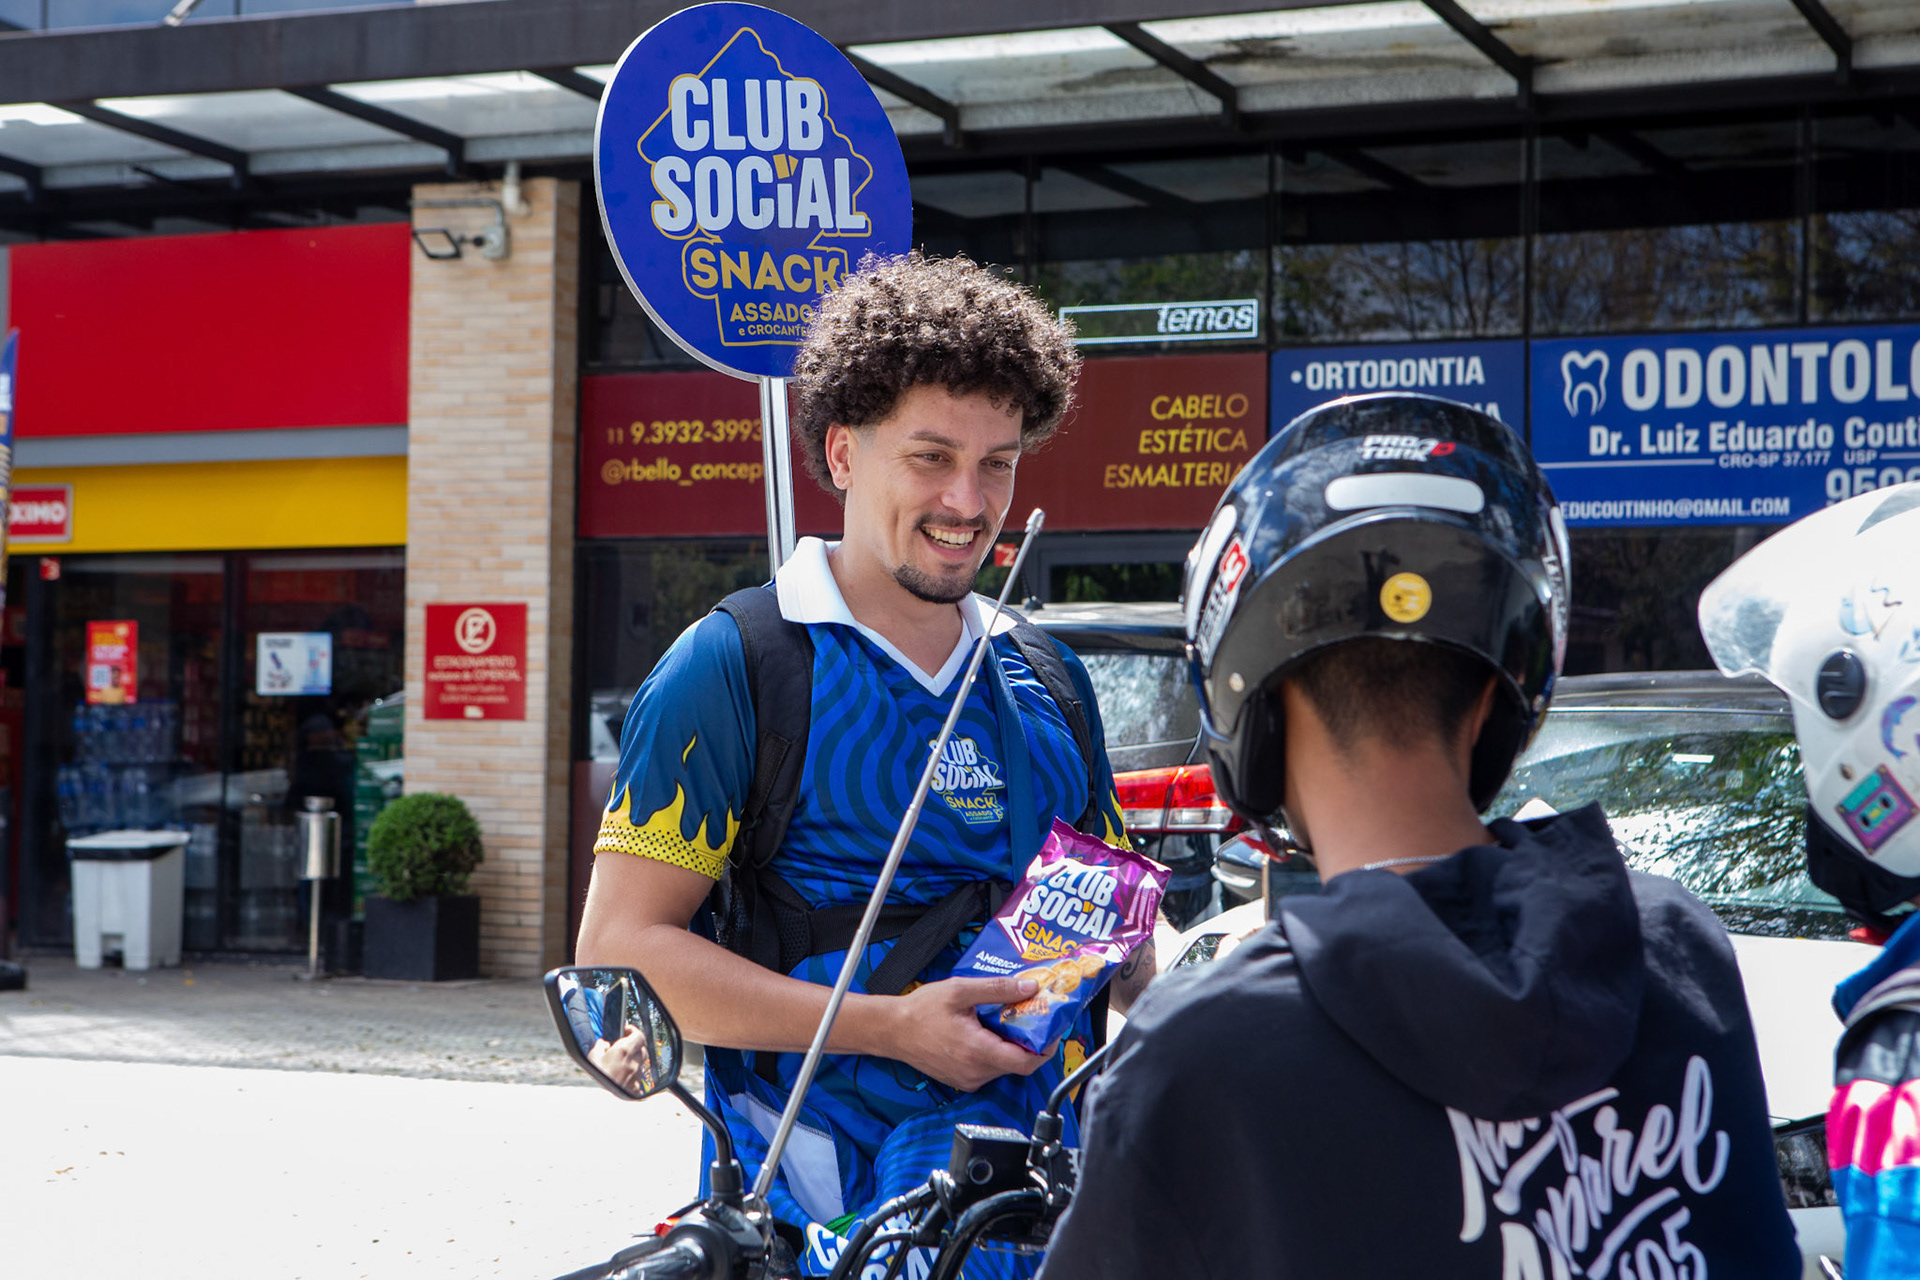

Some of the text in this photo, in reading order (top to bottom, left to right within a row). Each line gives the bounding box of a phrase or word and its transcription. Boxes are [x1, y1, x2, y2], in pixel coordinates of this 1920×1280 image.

[671, 76, 824, 151] CLUB
[690, 248, 841, 294] SNACK
[730, 302, 815, 323] ASSADO
[1157, 304, 1253, 333] temos
[738, 327, 746, 336] e
[1305, 356, 1486, 390] ORTODONTIA
[1151, 393, 1249, 420] CABELO
[607, 418, 762, 445] 11 9.3932-3993
[1138, 422, 1249, 454] ESTÉTICA
[1363, 434, 1420, 447] PRO
[1589, 416, 1920, 456] Dr. Luiz Eduardo Cout
[1361, 446, 1428, 462] TORK
[1718, 450, 1878, 469] CRO-SP 37.177 USP
[601, 456, 765, 486] @rbello_concep
[945, 795, 998, 809] SNACK
